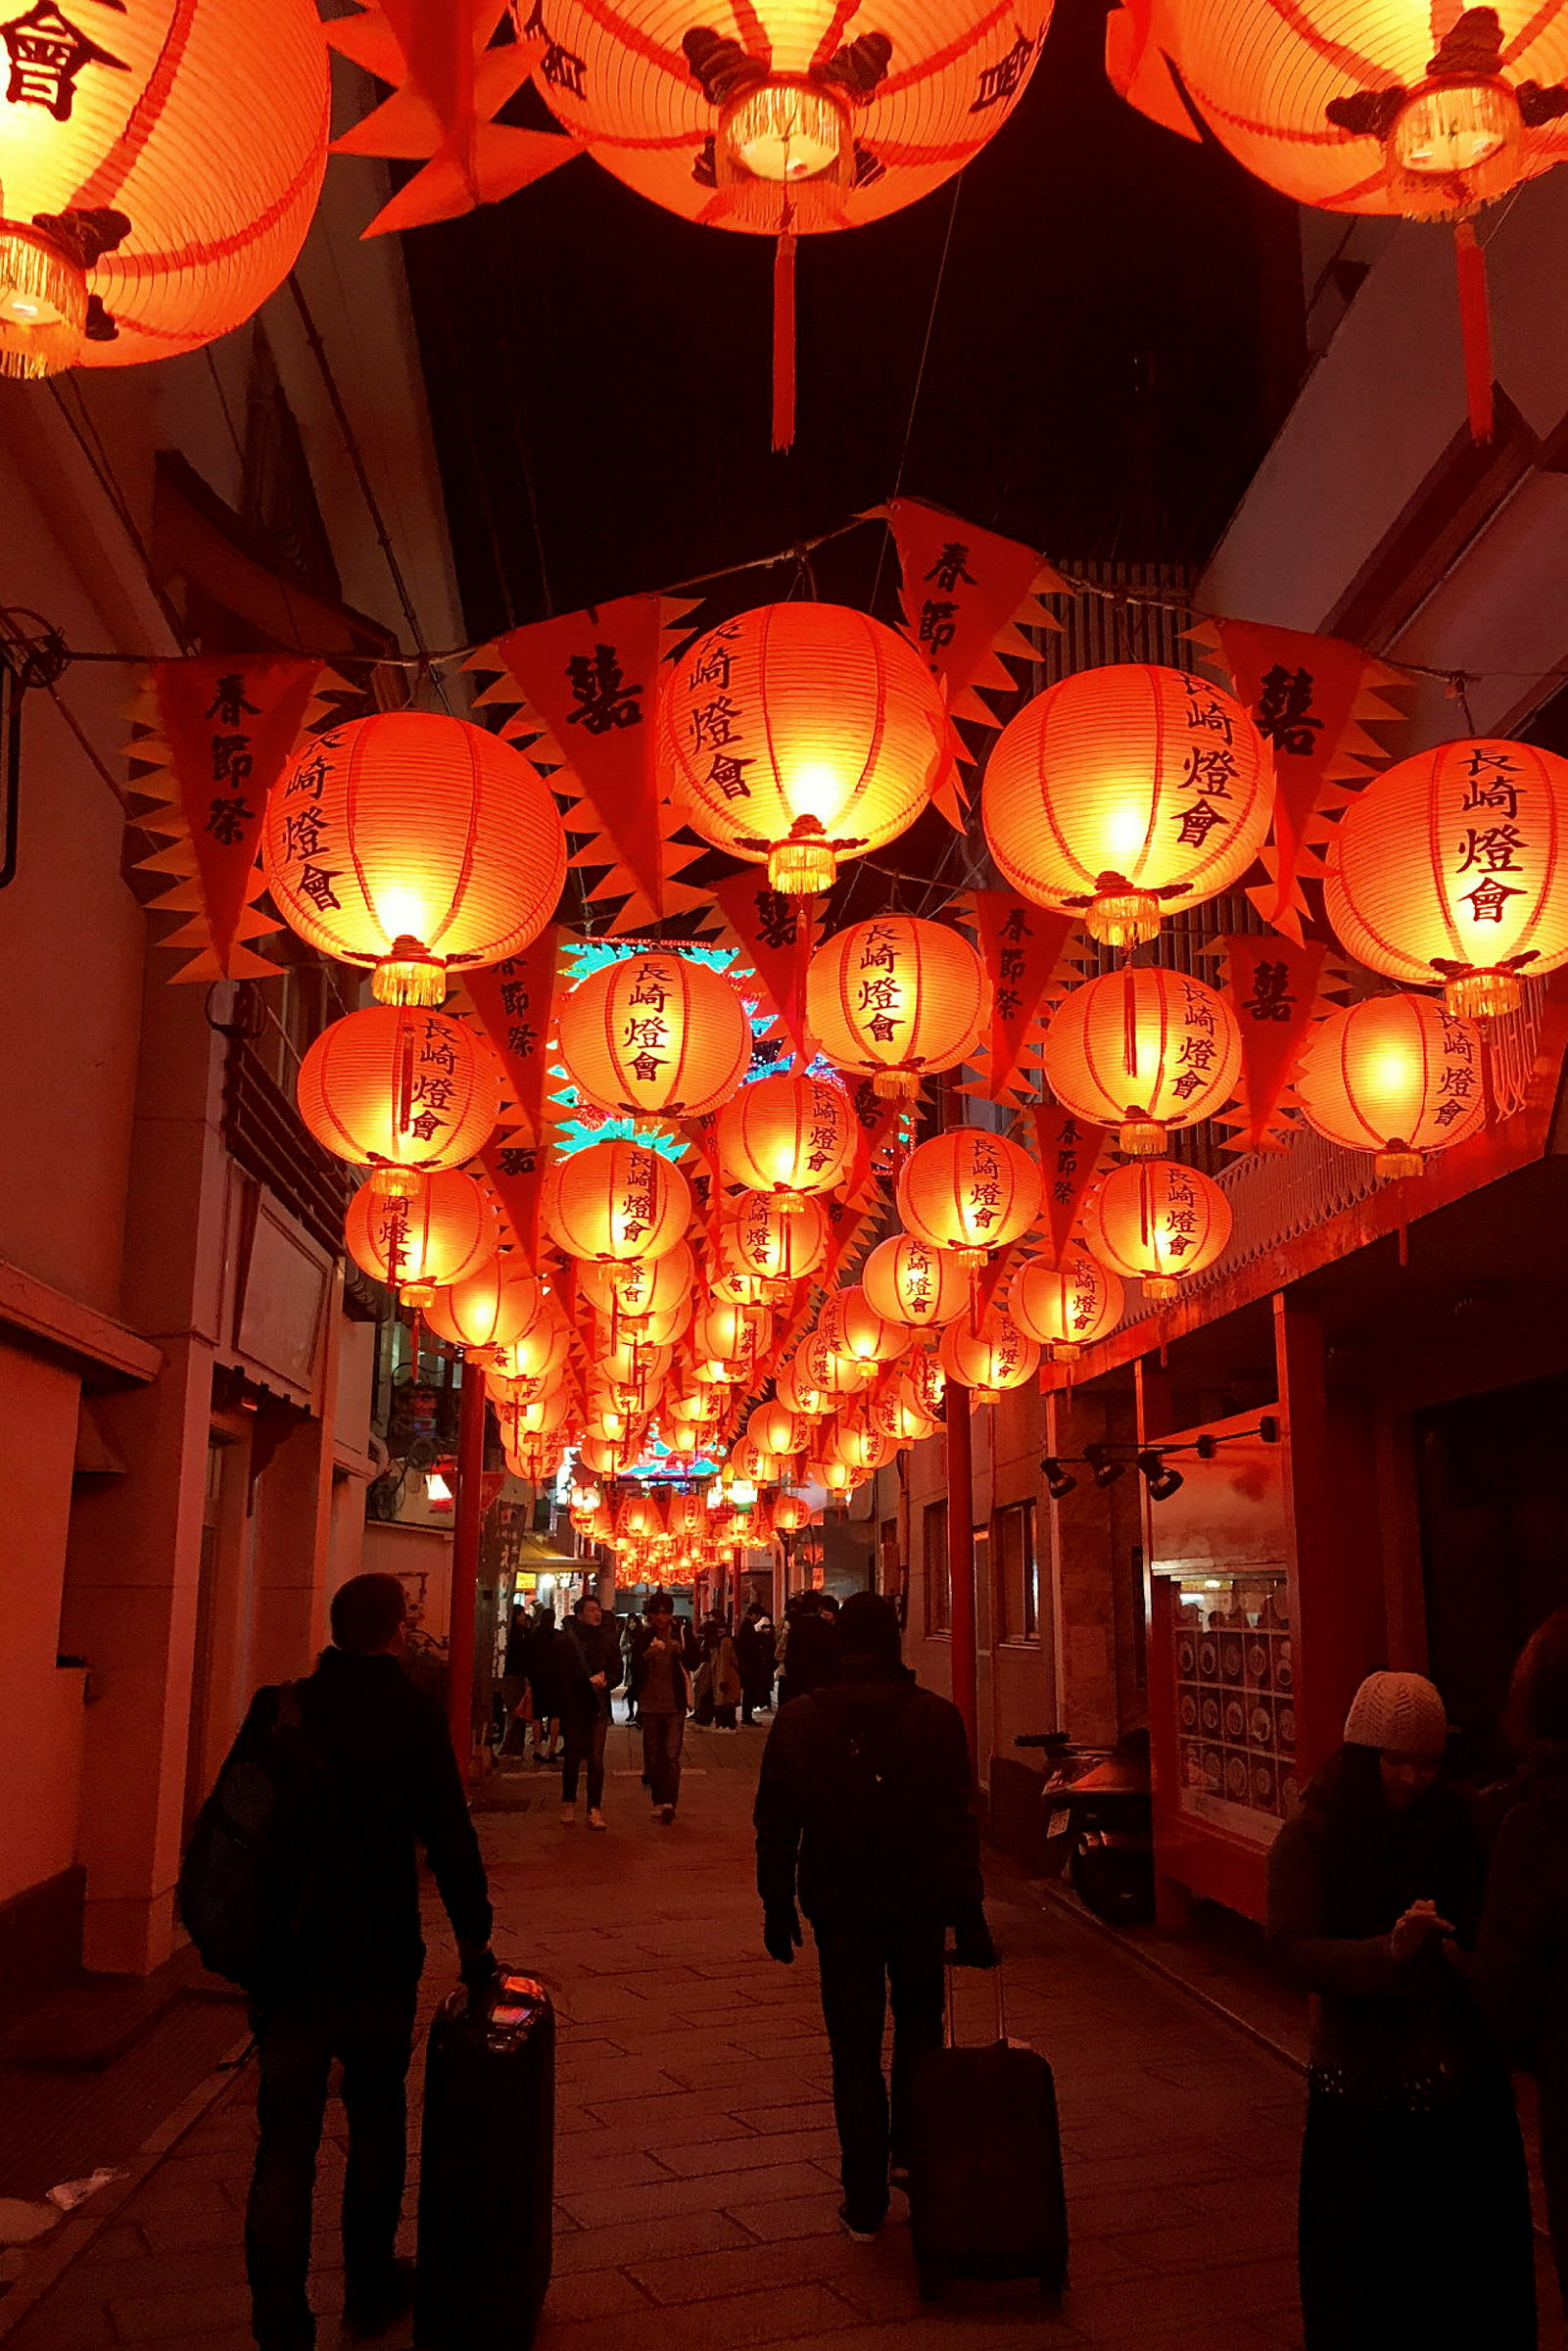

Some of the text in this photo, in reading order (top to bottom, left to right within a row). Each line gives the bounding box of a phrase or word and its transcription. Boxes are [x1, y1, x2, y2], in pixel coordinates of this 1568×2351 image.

[918, 542, 978, 673] 春節
[203, 672, 262, 845] 春節祭
[689, 619, 756, 800] 長崎燈會
[1170, 673, 1240, 848] 長崎燈會
[282, 729, 345, 912] 長崎燈會
[1454, 747, 1532, 924] 長崎燈會
[624, 962, 673, 1081] 長崎燈會
[858, 923, 906, 1042] 長崎燈會
[995, 907, 1035, 1020] 春節祭
[409, 1018, 458, 1142] 長崎燈會
[1170, 982, 1217, 1099] 長崎燈會
[1433, 1006, 1477, 1128] 長崎燈會
[805, 1085, 839, 1173] 長崎燈會
[967, 1138, 1002, 1229] 長崎燈會
[1050, 1119, 1083, 1206] 春節祭
[622, 1150, 651, 1243] 長崎燈會
[746, 1193, 772, 1265] 長崎燈會
[1165, 1168, 1200, 1256] 長崎燈會
[906, 1240, 932, 1313] 長崎燈會
[1072, 1259, 1099, 1330] 長崎燈會
